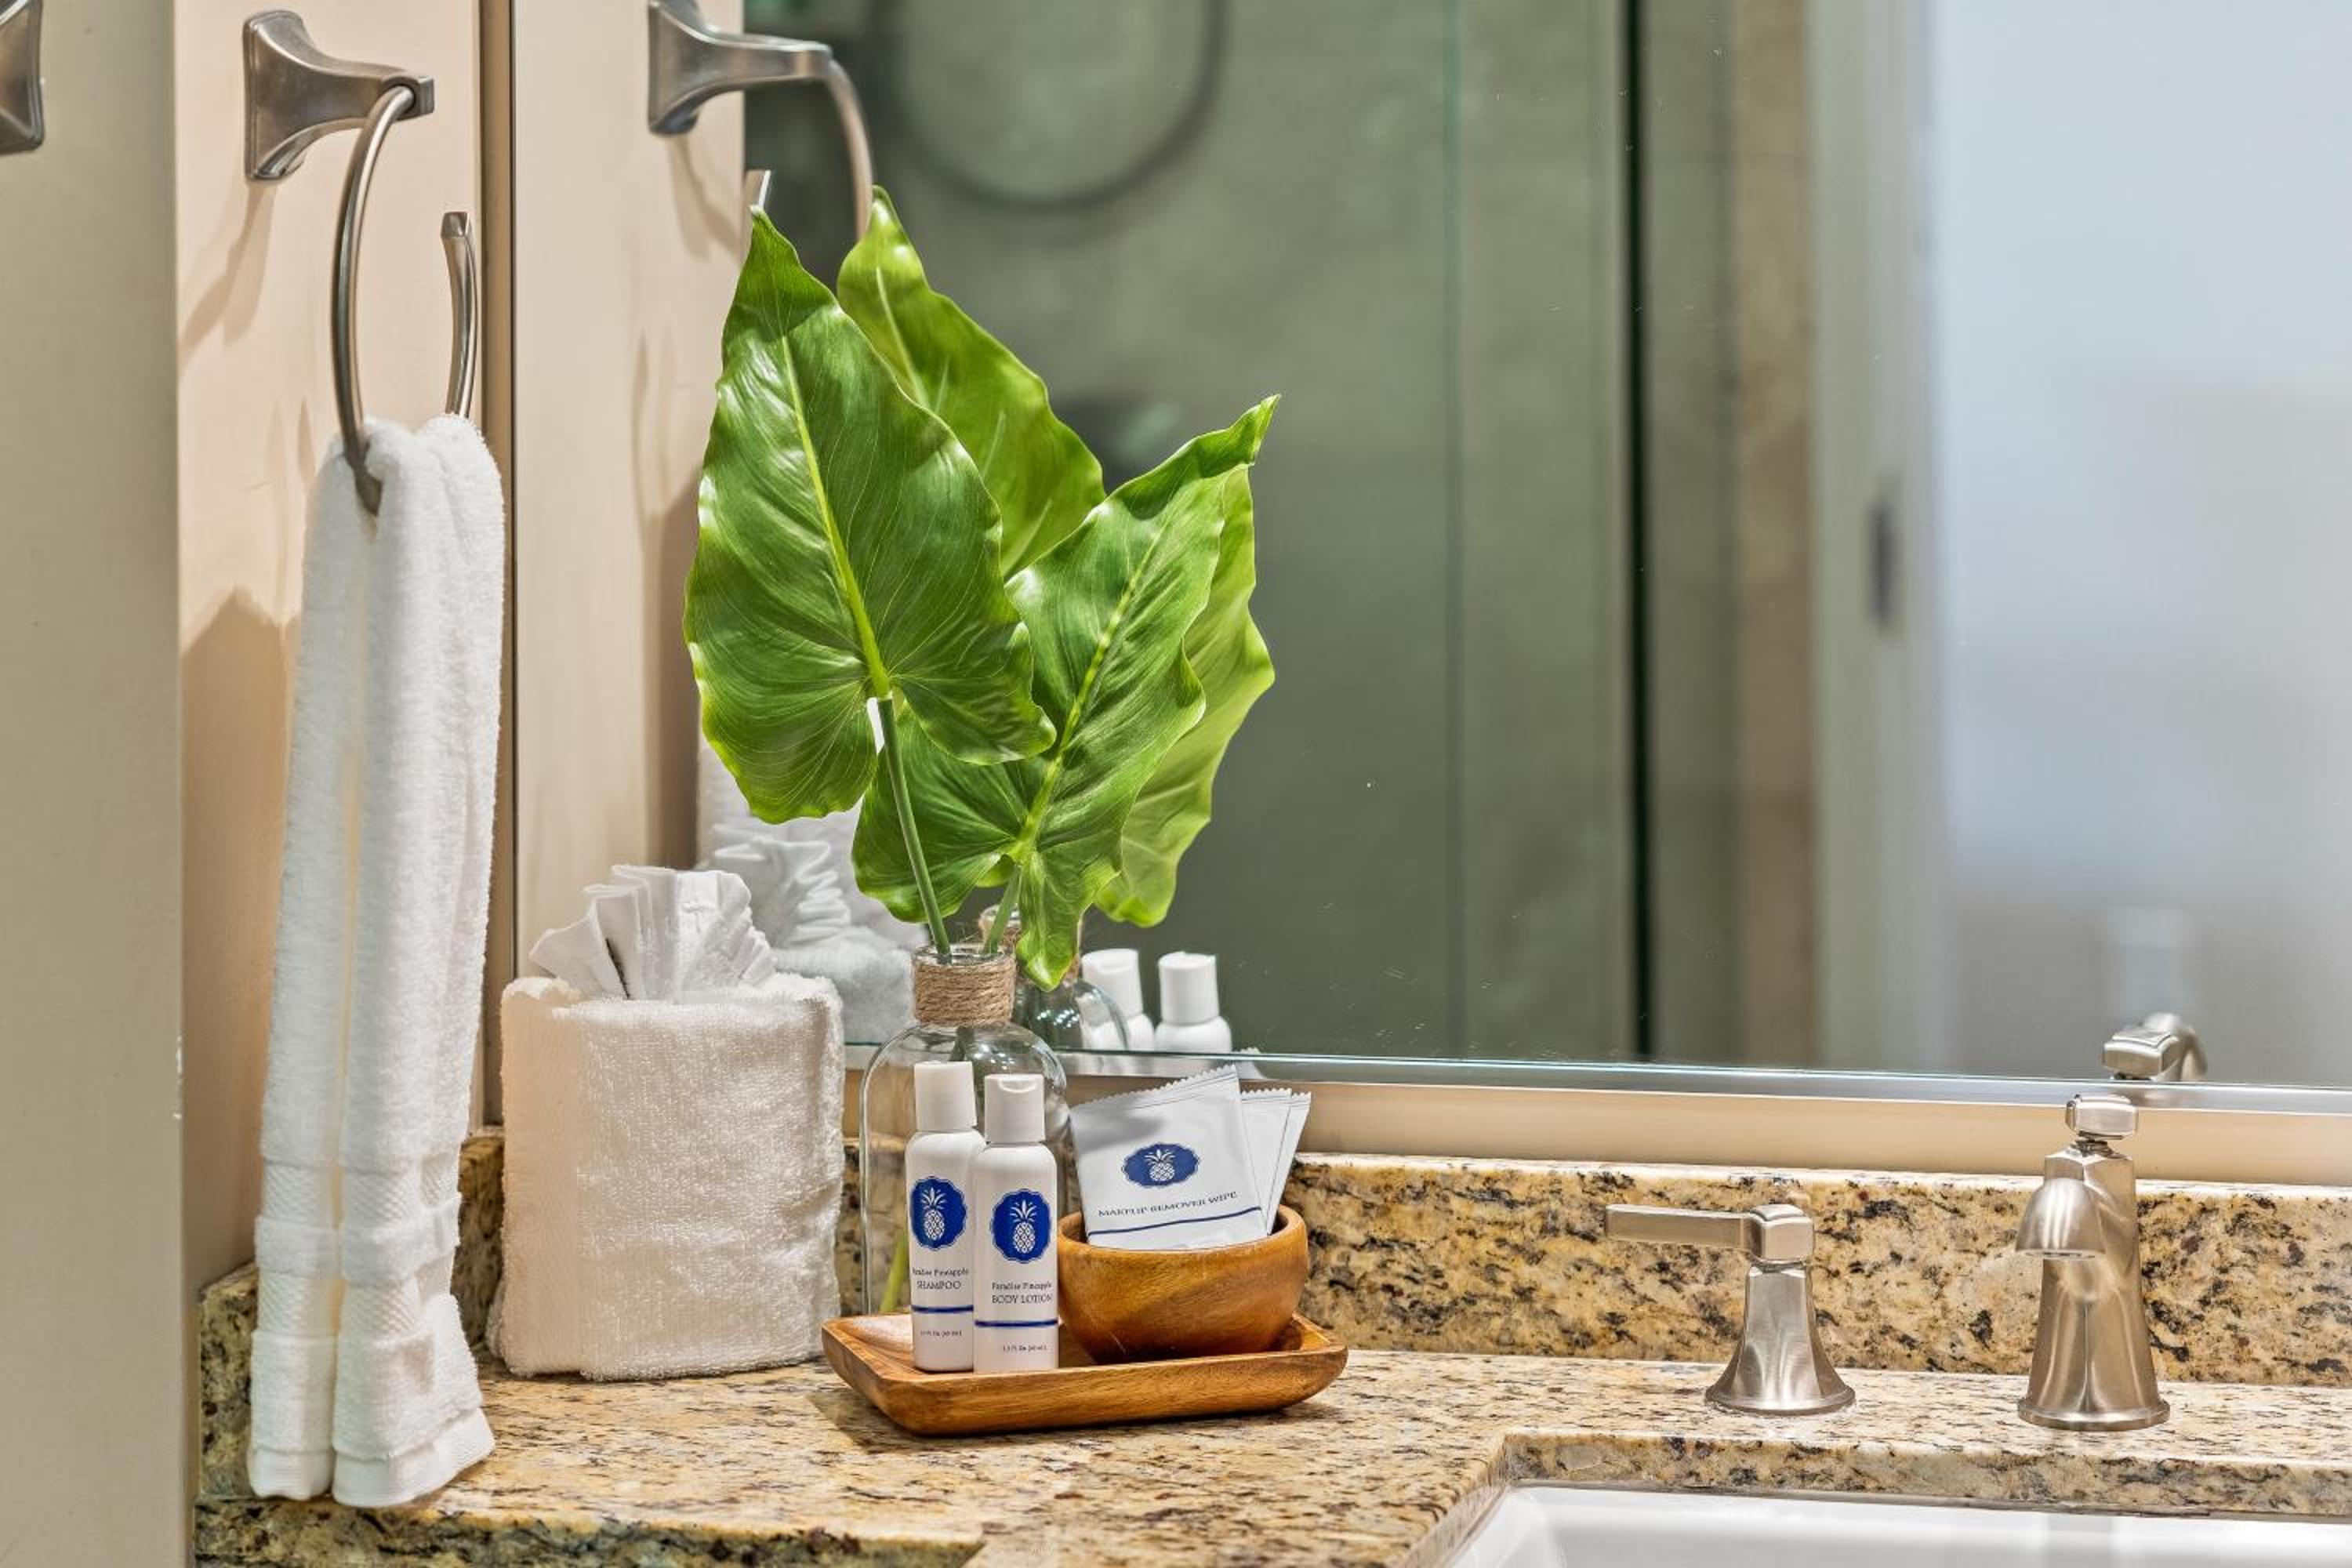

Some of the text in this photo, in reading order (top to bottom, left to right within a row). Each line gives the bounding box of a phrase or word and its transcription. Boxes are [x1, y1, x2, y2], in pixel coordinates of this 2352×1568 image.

[1098, 1191, 1238, 1217] MAKEUP REMOVER WIPE
[916, 1280, 962, 1290] SHAMPOO
[992, 1294, 1052, 1304] BODY LOTION
